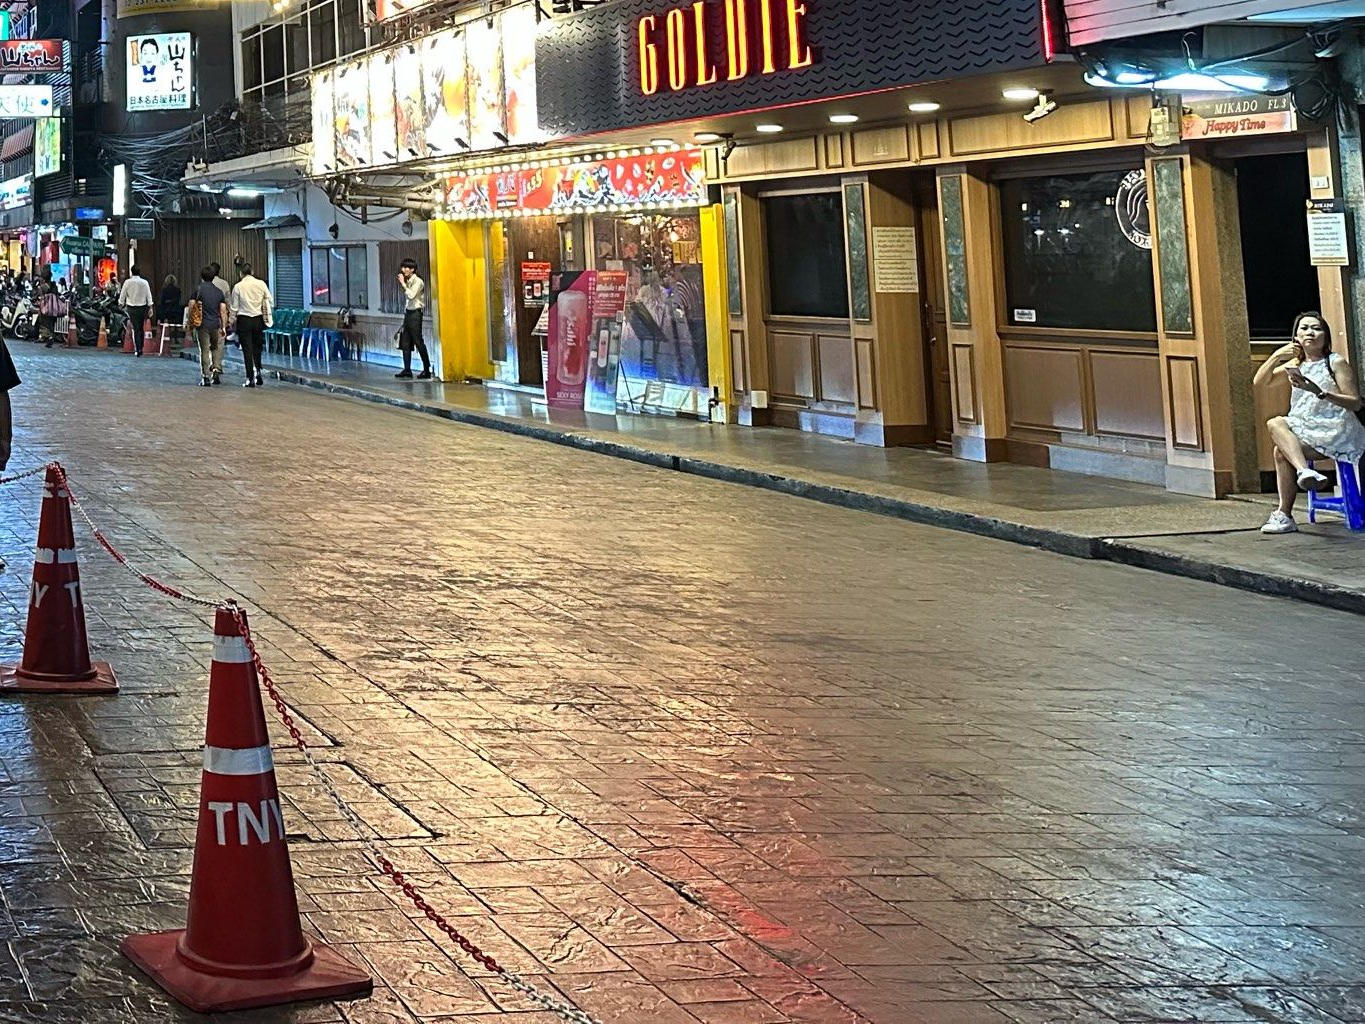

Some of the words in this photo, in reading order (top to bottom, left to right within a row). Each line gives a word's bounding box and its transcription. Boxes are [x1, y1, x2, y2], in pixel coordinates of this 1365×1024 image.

[1214, 99, 1259, 115] MIKADO
[1202, 118, 1239, 136] Happy
[1239, 118, 1266, 132] Time
